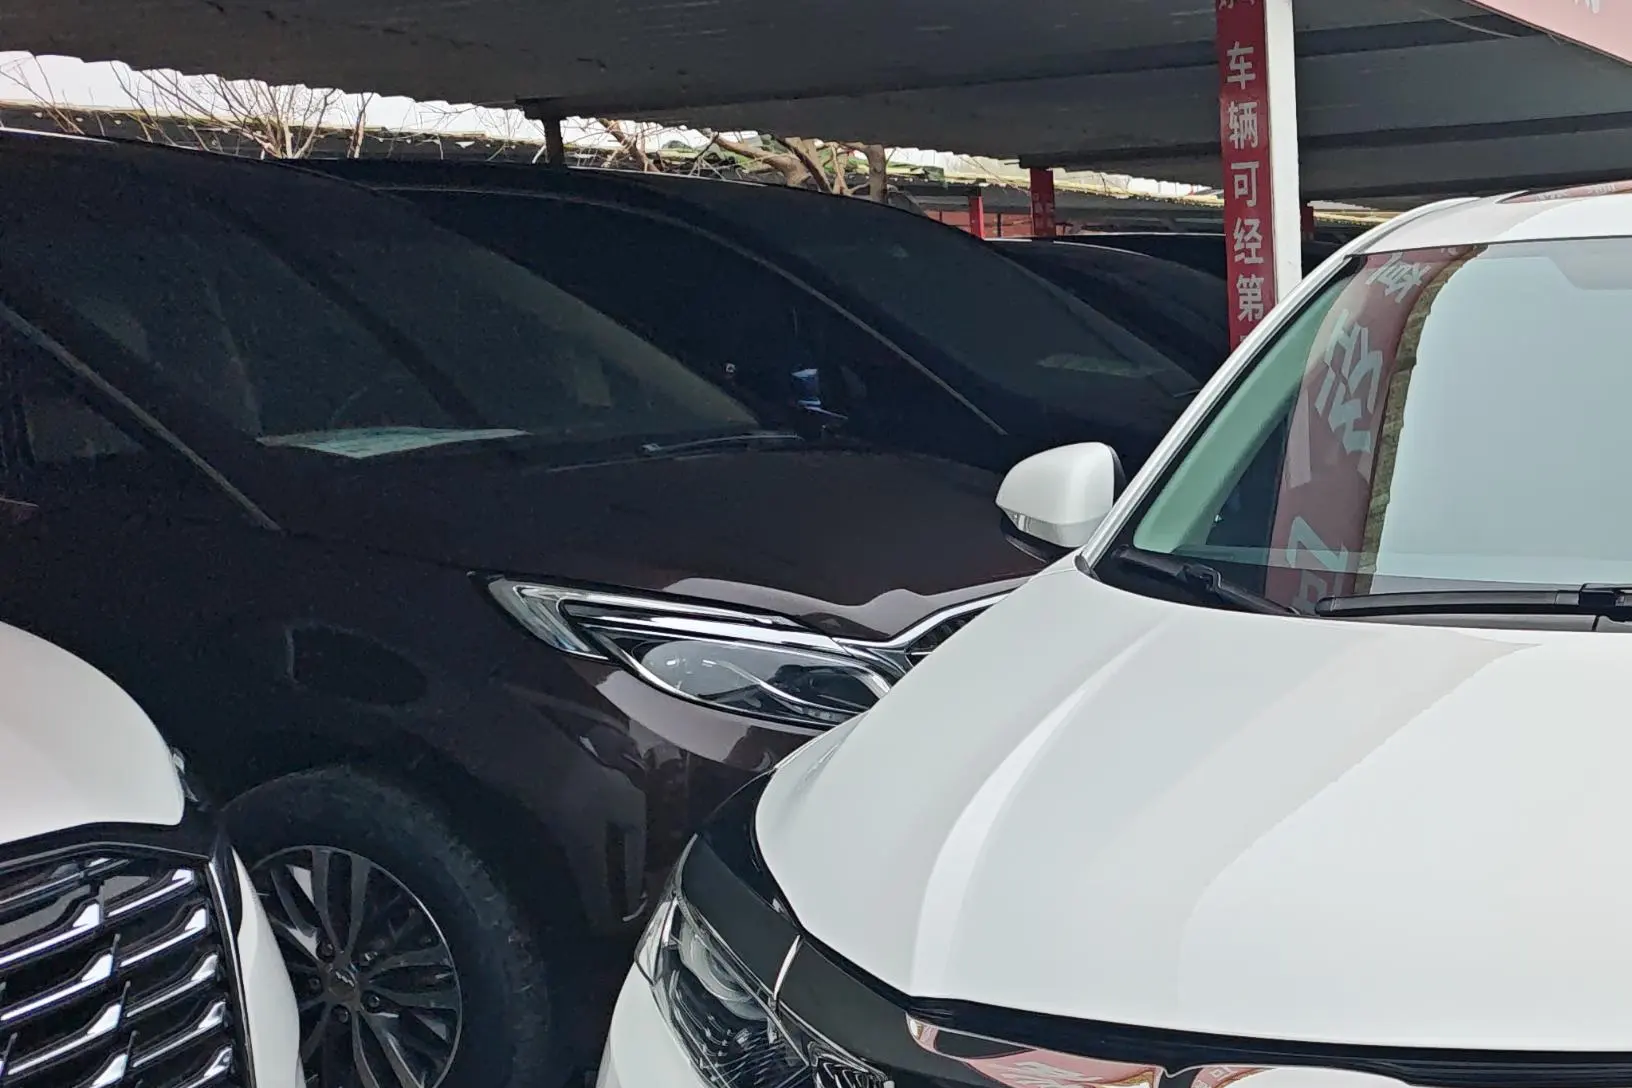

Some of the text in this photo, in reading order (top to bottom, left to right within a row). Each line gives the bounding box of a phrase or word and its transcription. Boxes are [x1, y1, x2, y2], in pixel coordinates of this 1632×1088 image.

[1226, 41, 1265, 341] 车辆可经第
